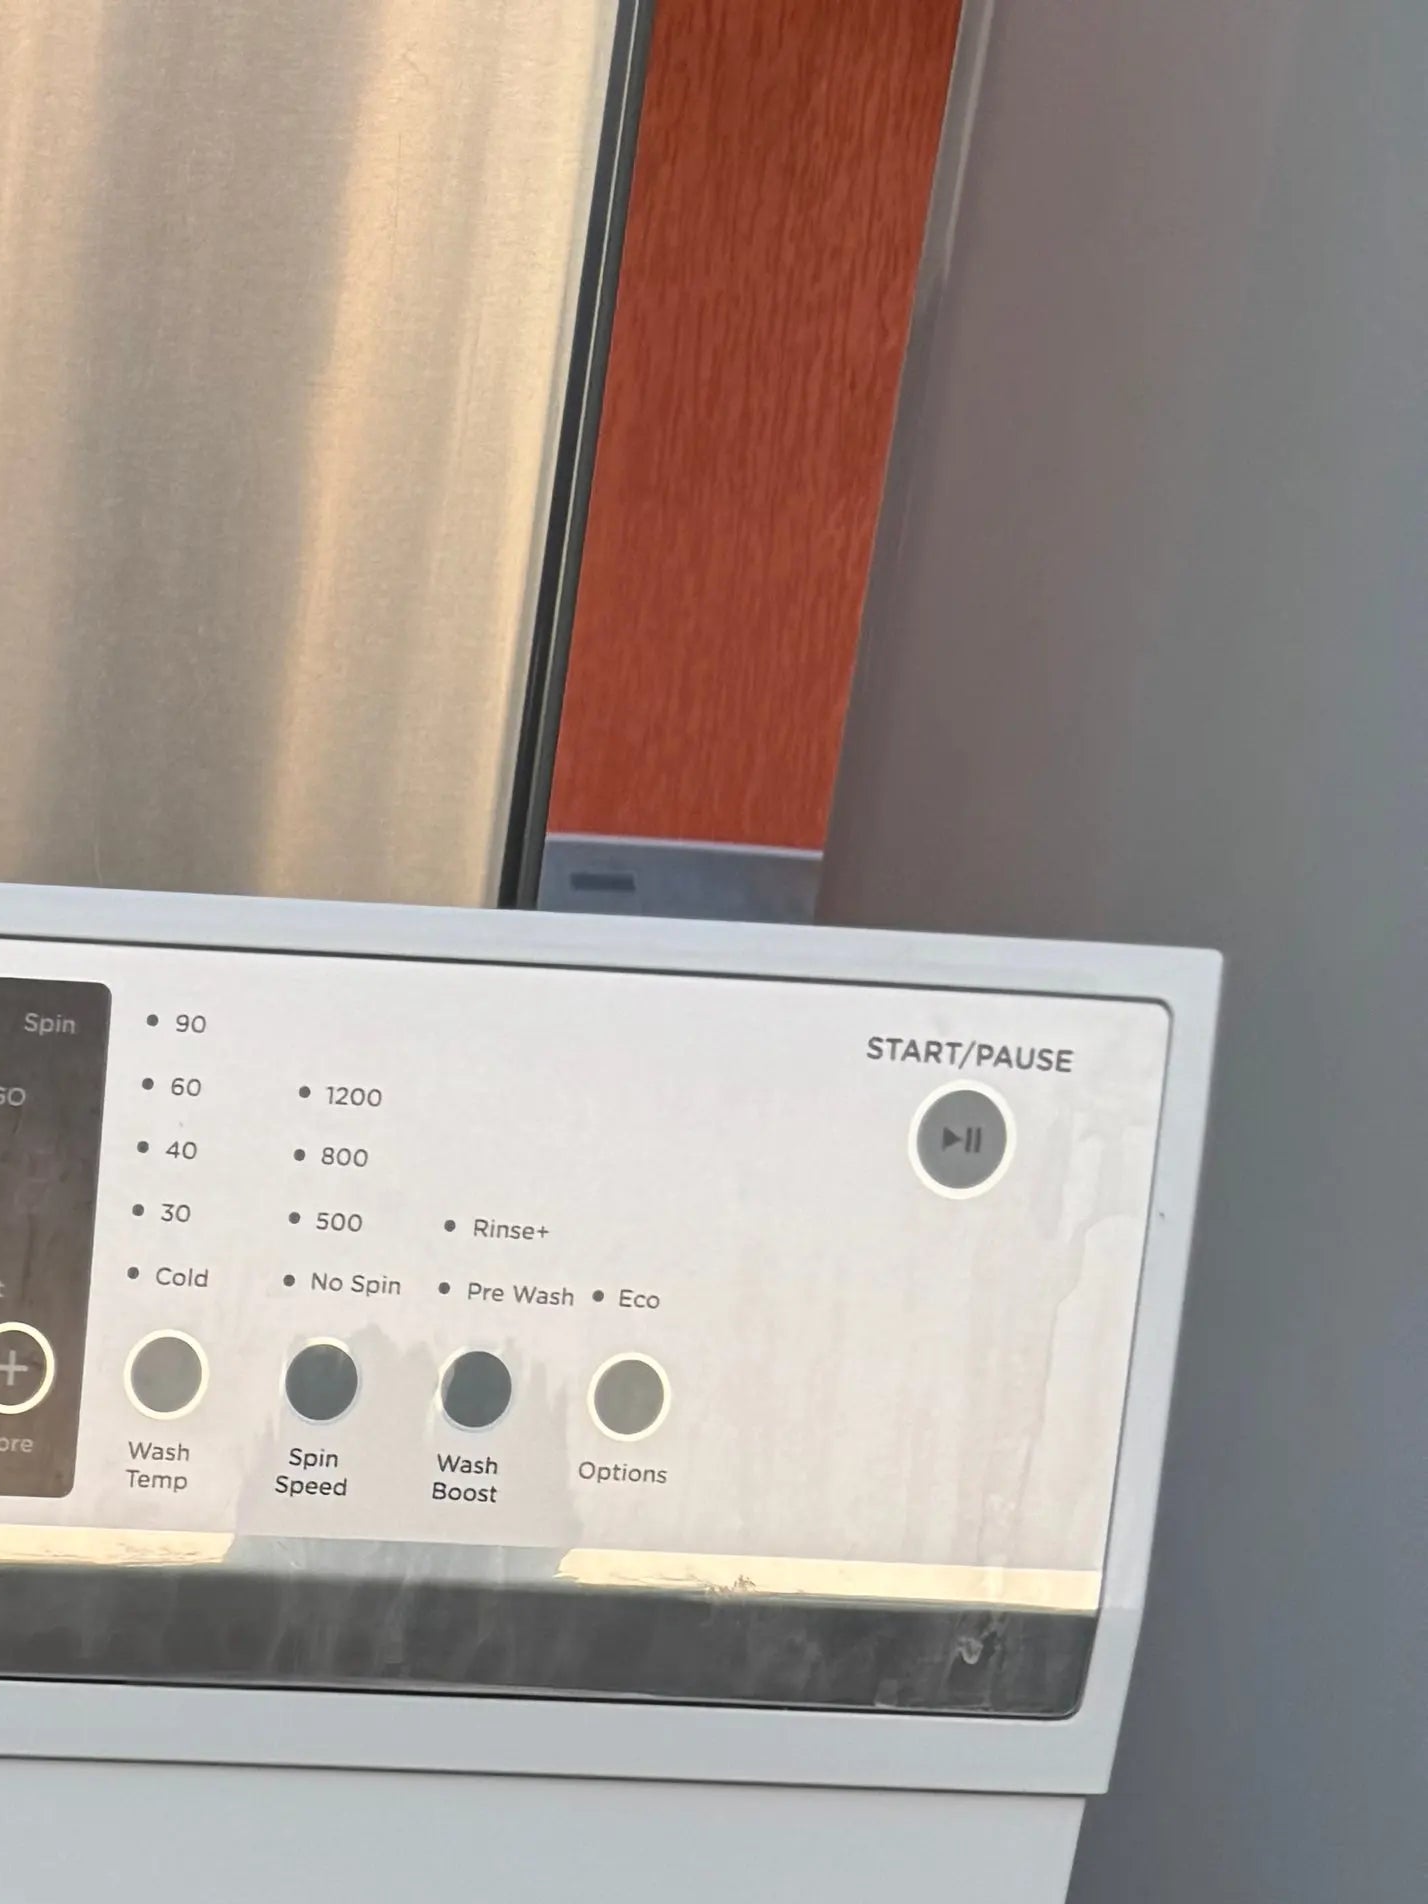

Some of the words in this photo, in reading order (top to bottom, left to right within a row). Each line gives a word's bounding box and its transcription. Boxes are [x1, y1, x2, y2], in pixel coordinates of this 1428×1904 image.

[25, 1013, 75, 1035] Spin
[176, 1015, 206, 1033] 90
[867, 1037, 1073, 1072] START/PAUSE
[172, 1078, 201, 1096] 60
[327, 1087, 381, 1106] 1200
[166, 1141, 197, 1159] 40
[322, 1147, 368, 1167] 800
[161, 1204, 190, 1222] 30
[317, 1213, 362, 1232] 500
[474, 1219, 549, 1240] Rinse+
[156, 1267, 208, 1287] Cold
[312, 1273, 343, 1291] No
[351, 1275, 400, 1296] Spin
[468, 1283, 504, 1301] Pre
[514, 1286, 573, 1306] Wash
[619, 1289, 659, 1309] Eco
[129, 1442, 189, 1461] Wash
[289, 1448, 338, 1469] Spin
[438, 1454, 497, 1474] Wash
[579, 1462, 667, 1483] Options
[126, 1469, 187, 1492] Temp
[275, 1476, 347, 1496] Speed
[433, 1482, 497, 1503] Boost
